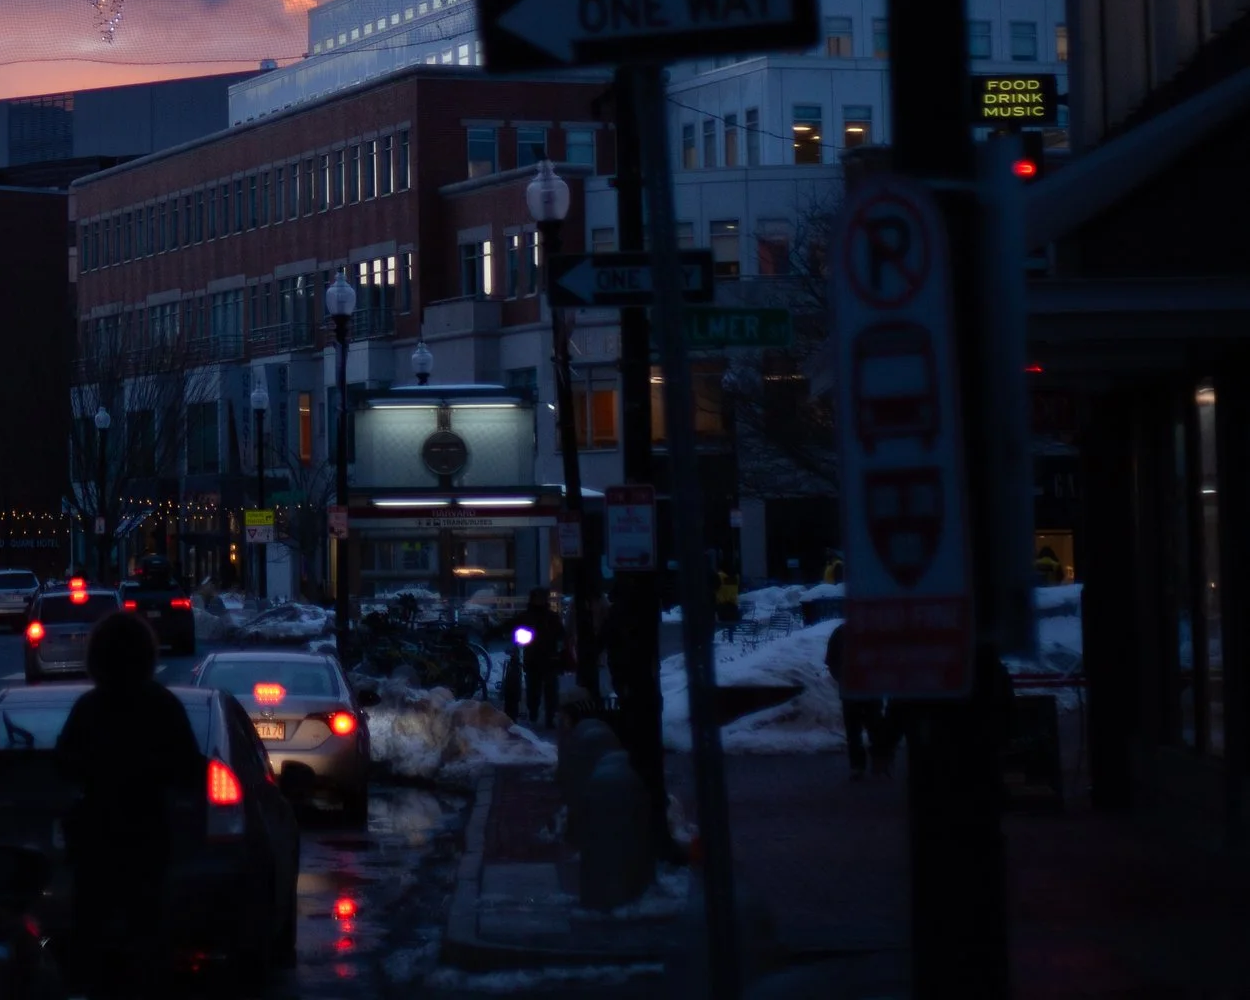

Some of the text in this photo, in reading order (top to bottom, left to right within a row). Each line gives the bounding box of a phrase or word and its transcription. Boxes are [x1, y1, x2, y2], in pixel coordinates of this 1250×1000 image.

[987, 80, 1040, 90] FOOD
[984, 93, 1043, 104] DRINK
[984, 106, 1045, 117] MUSIC
[596, 268, 641, 291] ONE
